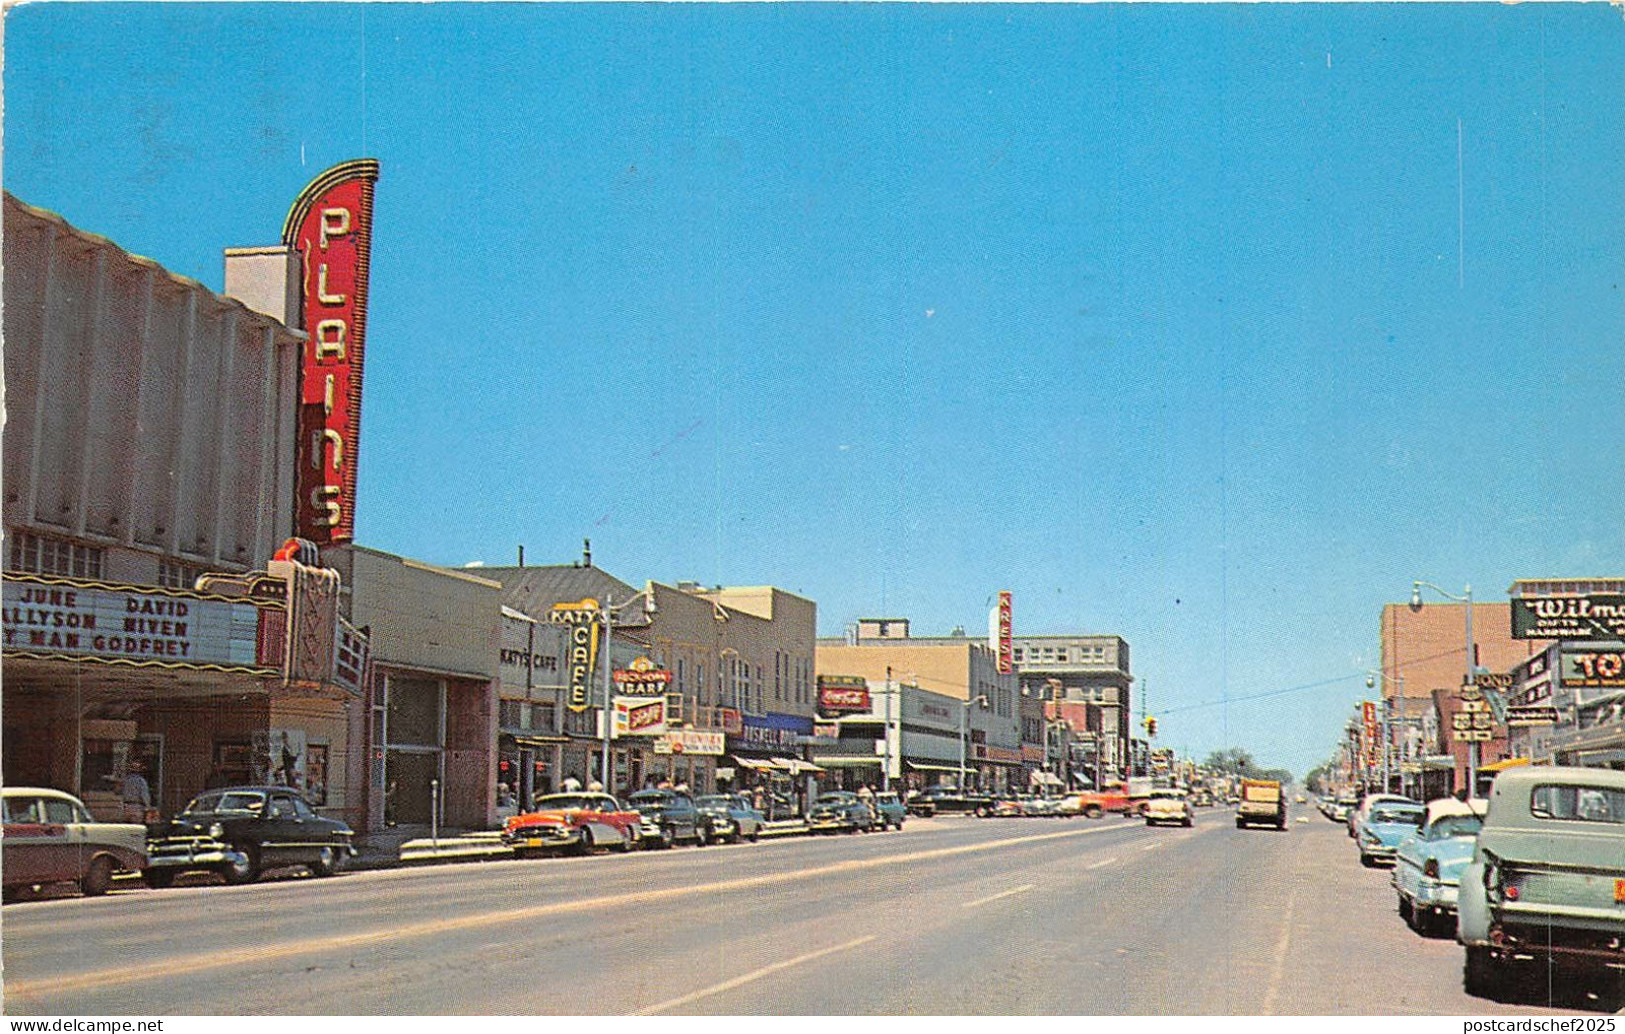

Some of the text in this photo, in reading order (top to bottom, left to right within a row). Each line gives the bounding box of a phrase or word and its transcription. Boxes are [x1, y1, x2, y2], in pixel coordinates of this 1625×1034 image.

[21, 589, 188, 617] JUNE DAVID
[124, 617, 188, 636] NIVEN
[999, 597, 1010, 671] KRESS
[30, 631, 79, 648] MAN
[93, 635, 190, 656] GODFREY
[534, 655, 557, 671] CAFE
[572, 627, 588, 702] CAFE
[1577, 653, 1625, 677] TO
[626, 683, 655, 694] BAR
